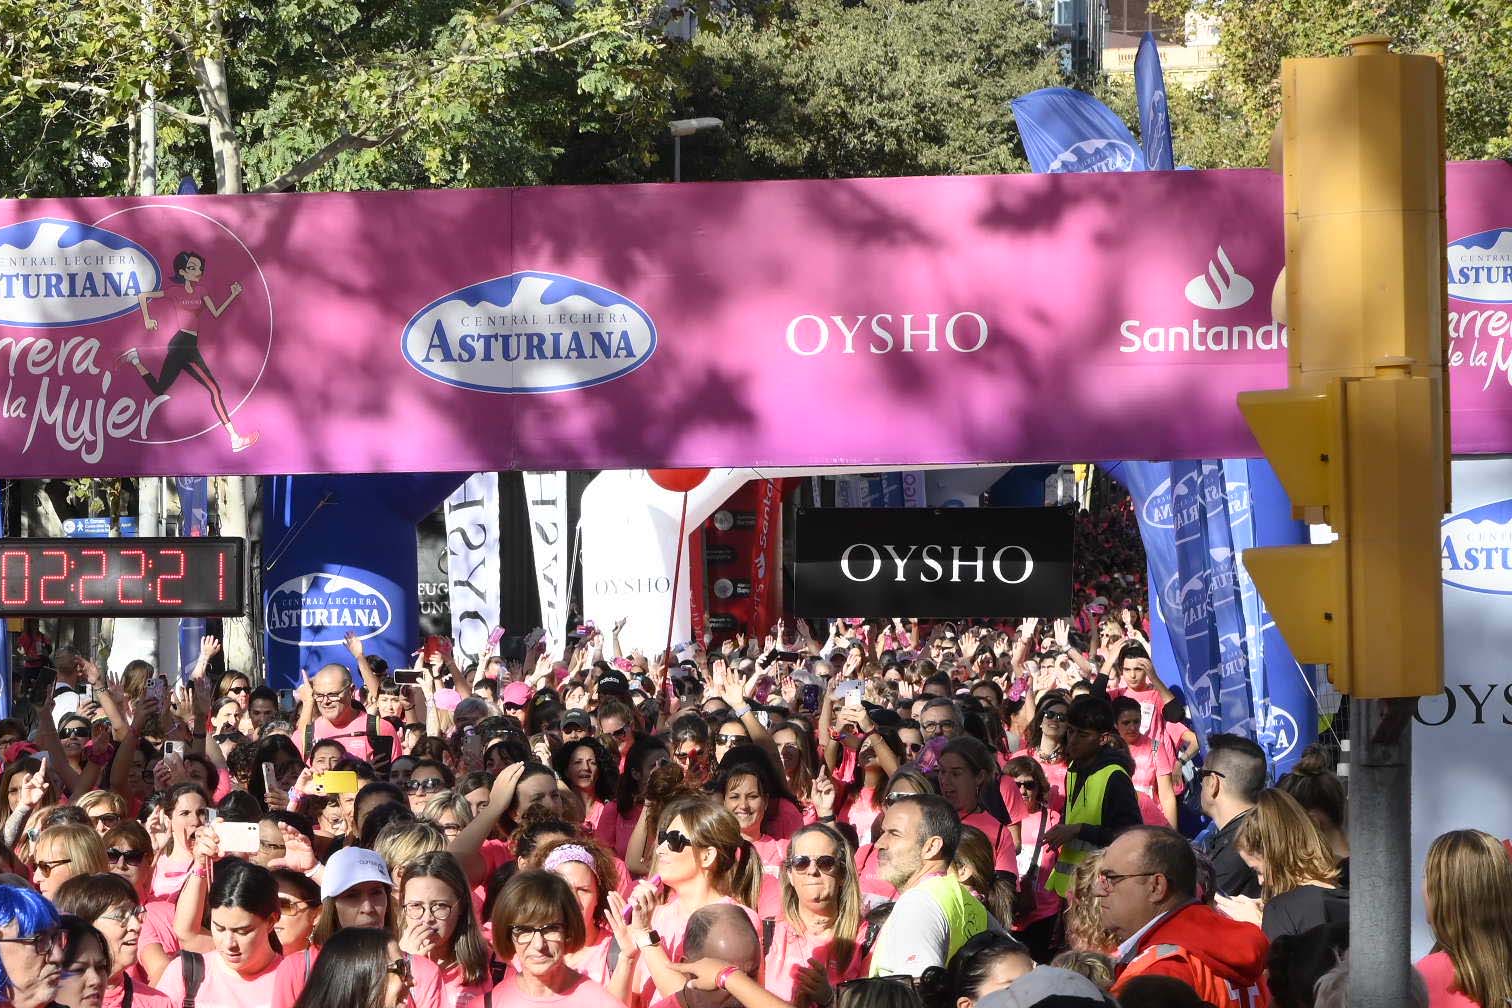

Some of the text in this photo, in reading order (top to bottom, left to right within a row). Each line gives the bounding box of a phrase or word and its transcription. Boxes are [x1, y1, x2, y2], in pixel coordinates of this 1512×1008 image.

[64, 254, 137, 266] LECHERA
[461, 311, 629, 328] CENTRAL LECHERA
[786, 312, 989, 356] OYSHO
[422, 318, 637, 364] ASTURIANA
[1469, 339, 1488, 367] la
[2, 378, 27, 418] la
[22, 373, 171, 464] Mujer
[1, 550, 224, 605] 02:22:21
[840, 543, 1034, 584] OYSHO
[268, 602, 383, 630] ASTURIANA
[329, 596, 378, 607] LECHERA
